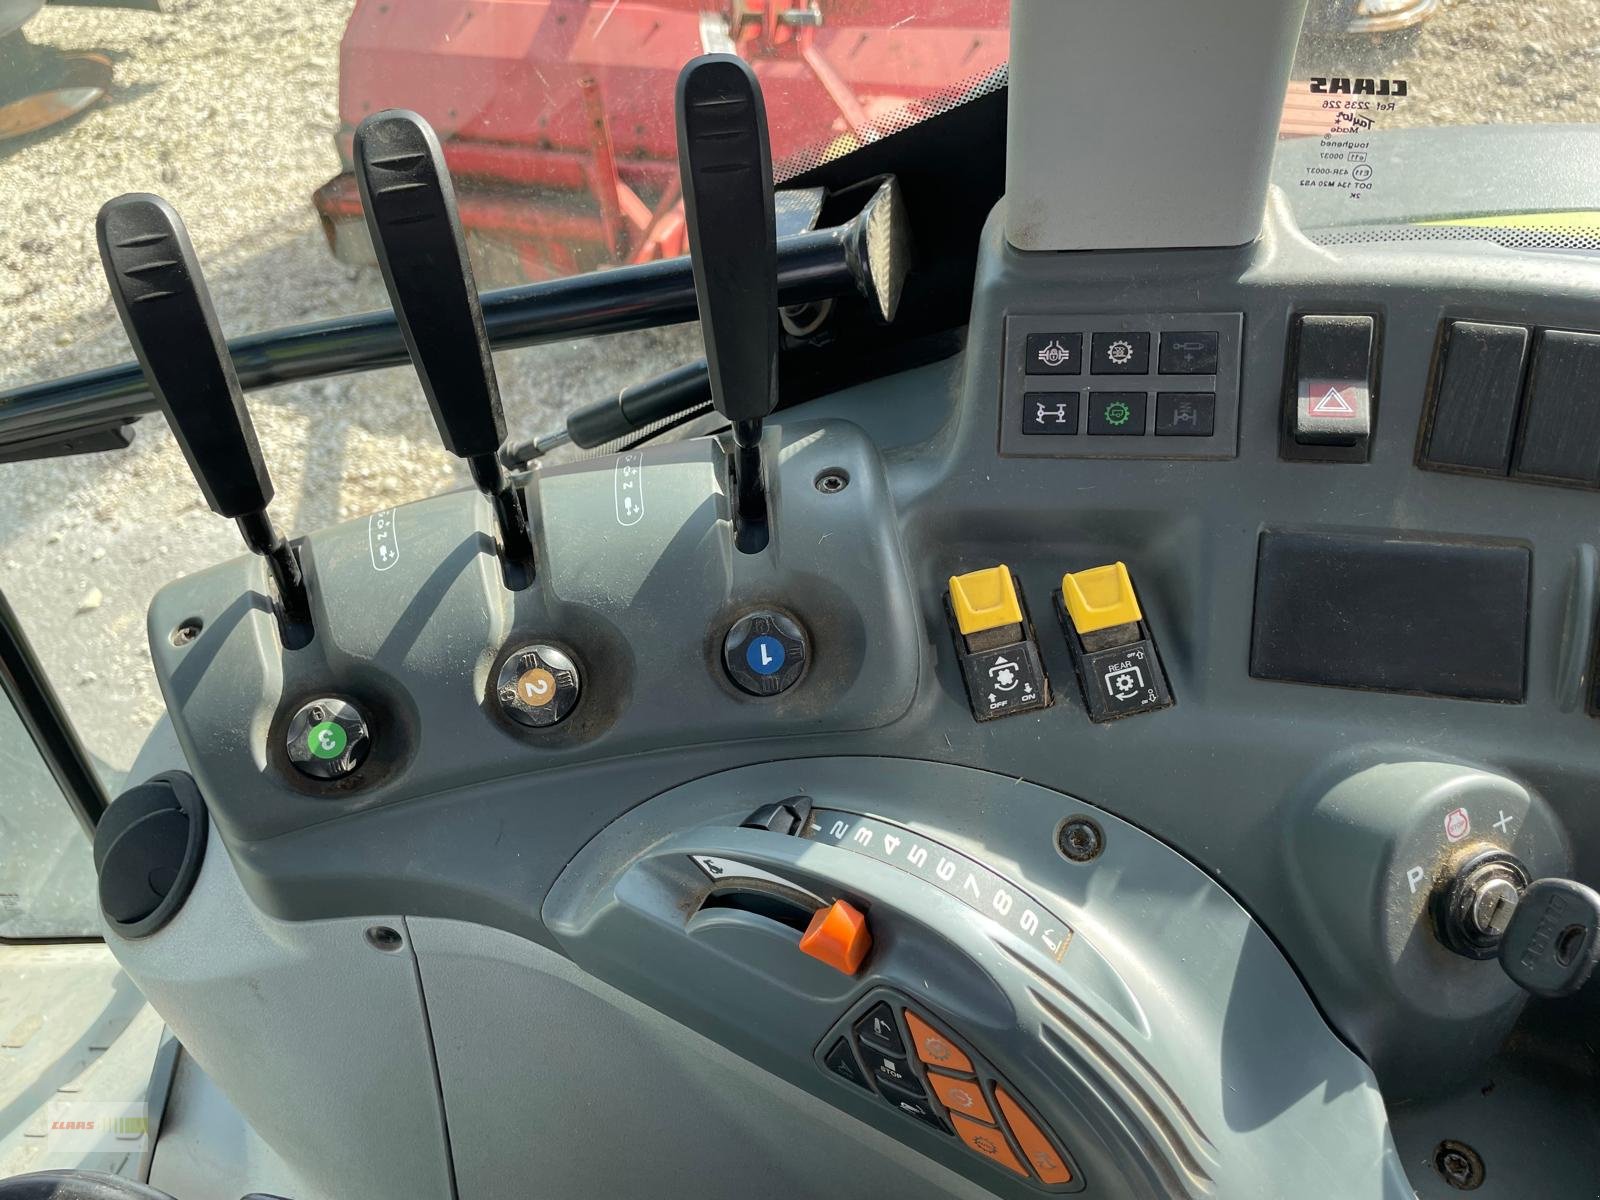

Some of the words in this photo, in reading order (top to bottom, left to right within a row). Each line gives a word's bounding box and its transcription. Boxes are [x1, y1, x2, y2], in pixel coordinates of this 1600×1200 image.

[760, 643, 773, 666] 1
[1108, 660, 1132, 673] REAR
[525, 679, 548, 697] 2
[989, 700, 1008, 710] OFF
[1021, 693, 1036, 702] ON
[318, 729, 336, 751] 3
[829, 820, 849, 840] 2
[854, 826, 873, 847] 3
[883, 833, 901, 855] 4
[907, 844, 928, 868] 5
[936, 857, 956, 881] 6
[963, 873, 981, 899] 7
[992, 889, 1013, 916] 8
[1020, 909, 1039, 937] 9
[1406, 866, 1424, 894] P
[880, 1065, 902, 1079] STOP
